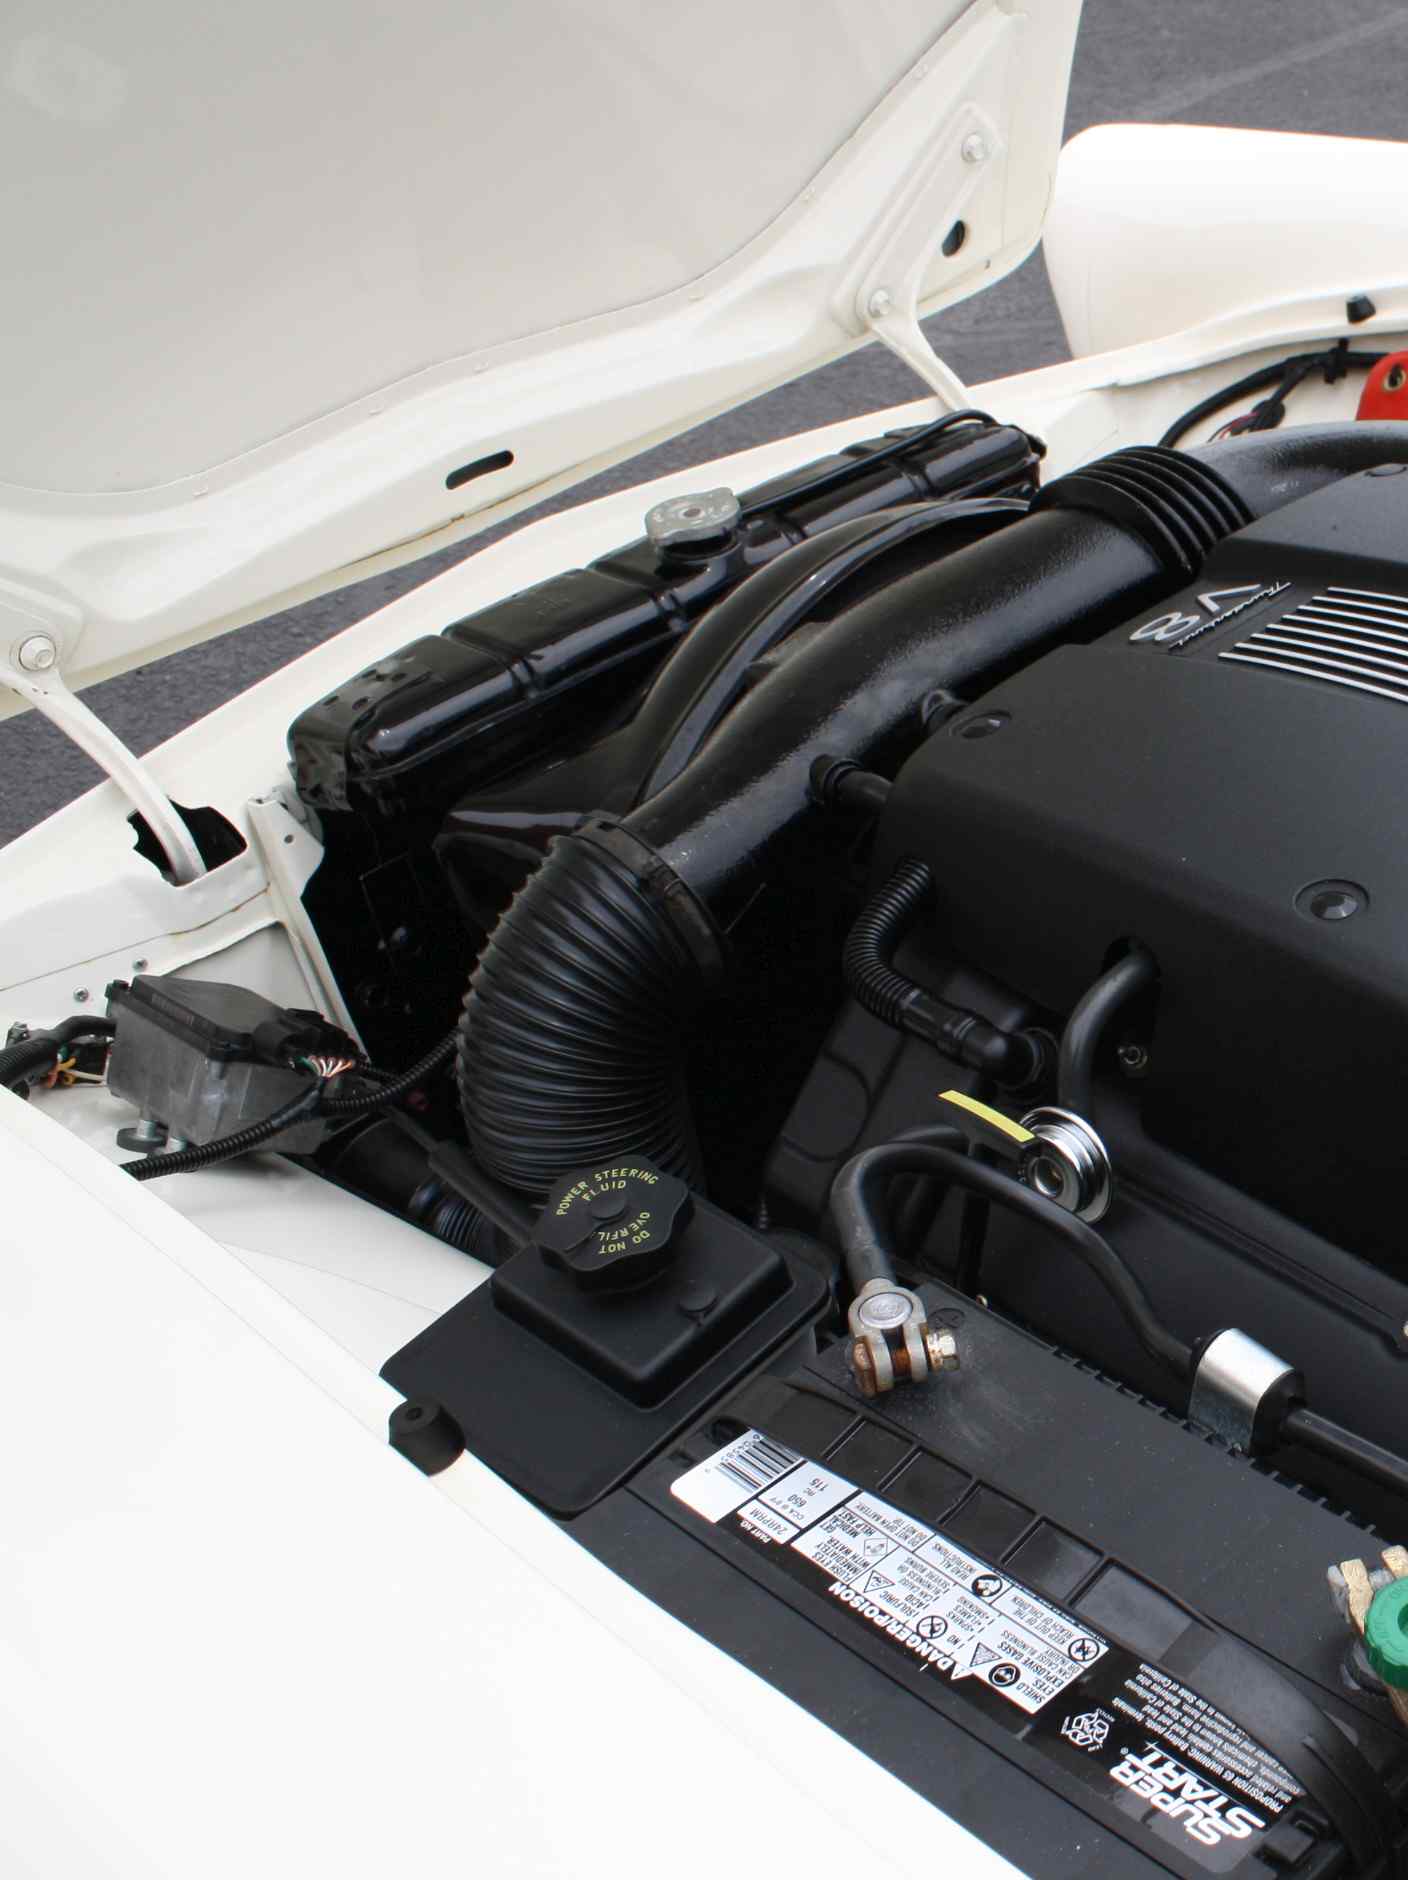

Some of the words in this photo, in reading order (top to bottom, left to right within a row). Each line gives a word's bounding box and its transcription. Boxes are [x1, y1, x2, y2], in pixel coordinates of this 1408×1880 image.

[1128, 583, 1262, 642] V8
[556, 1181, 588, 1216] POWER
[594, 1168, 659, 1185] STEERING
[582, 1180, 626, 1201] FLUID
[592, 1211, 651, 1241] OVERFIL
[632, 1230, 651, 1244] DO
[598, 1241, 627, 1255] NOT
[809, 1477, 828, 1491] 115
[787, 1493, 807, 1507] 650
[819, 1521, 836, 1533] GET
[829, 1514, 859, 1538] MEDICAL
[854, 1522, 876, 1536] HELP
[750, 1527, 772, 1543] PART
[811, 1551, 832, 1567] EYES
[816, 1542, 861, 1574] IMMEDIATELY
[849, 1552, 870, 1568] WITH
[828, 1564, 853, 1582] FLUSH
[950, 1566, 969, 1580] READ
[879, 1590, 915, 1616] SULFURIC
[904, 1593, 924, 1608] ACID
[829, 1582, 954, 1669] DANGER/POISON
[946, 1634, 960, 1645] NO
[1000, 1629, 1037, 1656] BLINDNESS
[997, 1641, 1024, 1660] GASES
[1035, 1652, 1059, 1670] CAUSE
[1022, 1657, 1064, 1687] EXPLOSIVE
[1055, 1666, 1072, 1679] CAN
[1015, 1682, 1045, 1703] SHIELD
[1168, 1682, 1179, 1691] of
[1153, 1698, 1165, 1707] of
[1177, 1687, 1197, 1703] State
[1141, 1704, 1160, 1719] lead
[1162, 1704, 1182, 1720] State
[1195, 1698, 1208, 1711] the
[1180, 1715, 1194, 1727] the
[1191, 1722, 1202, 1732] to
[1169, 1722, 1188, 1737] lead
[1163, 1729, 1189, 1751] Battery
[1221, 1769, 1235, 1781] 65
[1109, 1761, 1230, 1844] SUPER
[1125, 1751, 1266, 1838] START
[1232, 1777, 1282, 1812] PROPOSITION
